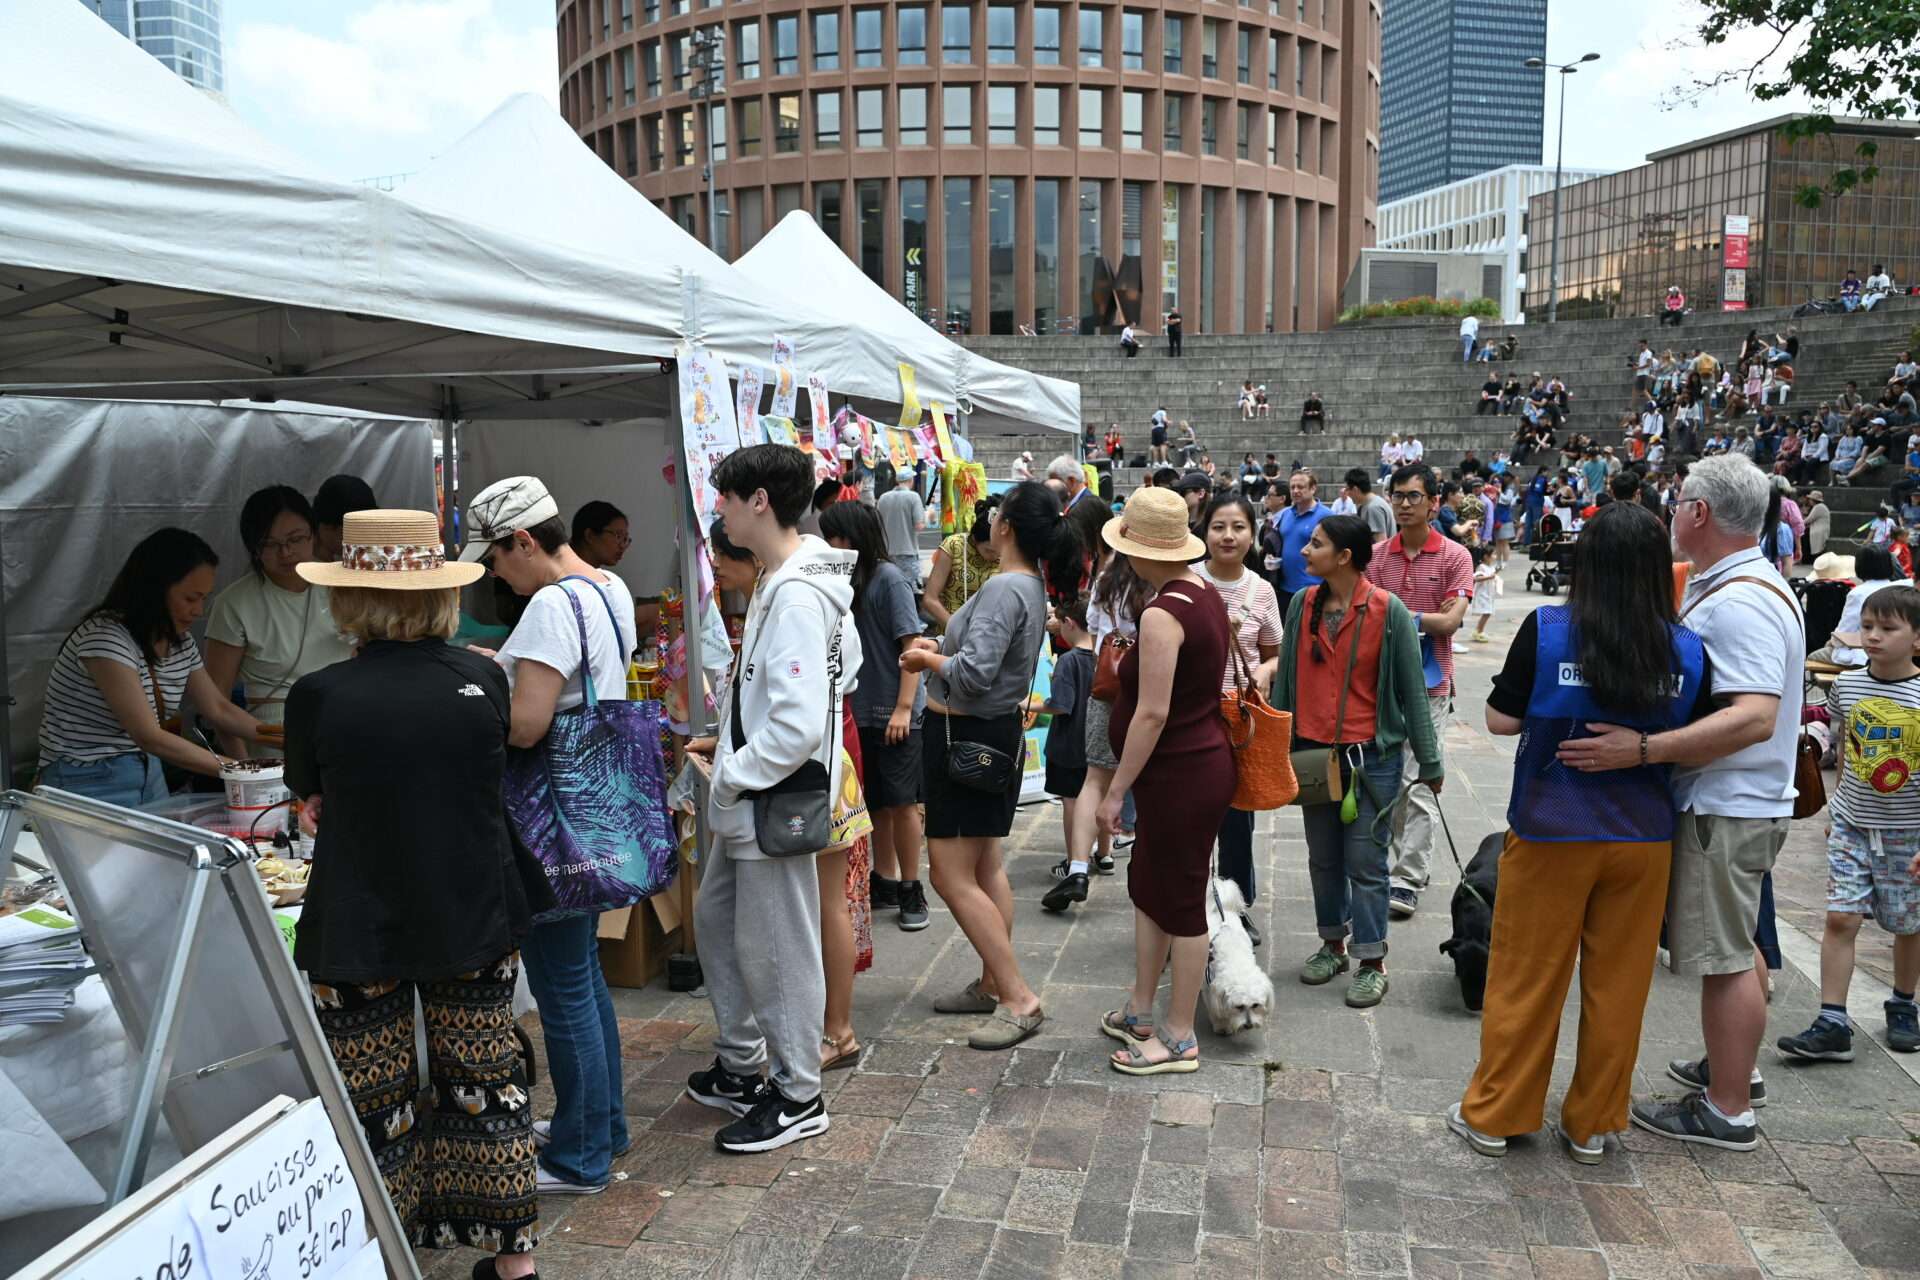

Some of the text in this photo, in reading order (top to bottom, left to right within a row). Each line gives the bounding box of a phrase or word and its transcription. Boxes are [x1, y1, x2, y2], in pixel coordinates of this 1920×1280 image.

[906, 270, 916, 298] PARK
[210, 1139, 316, 1233] Saucisse
[277, 1164, 344, 1236] au porc
